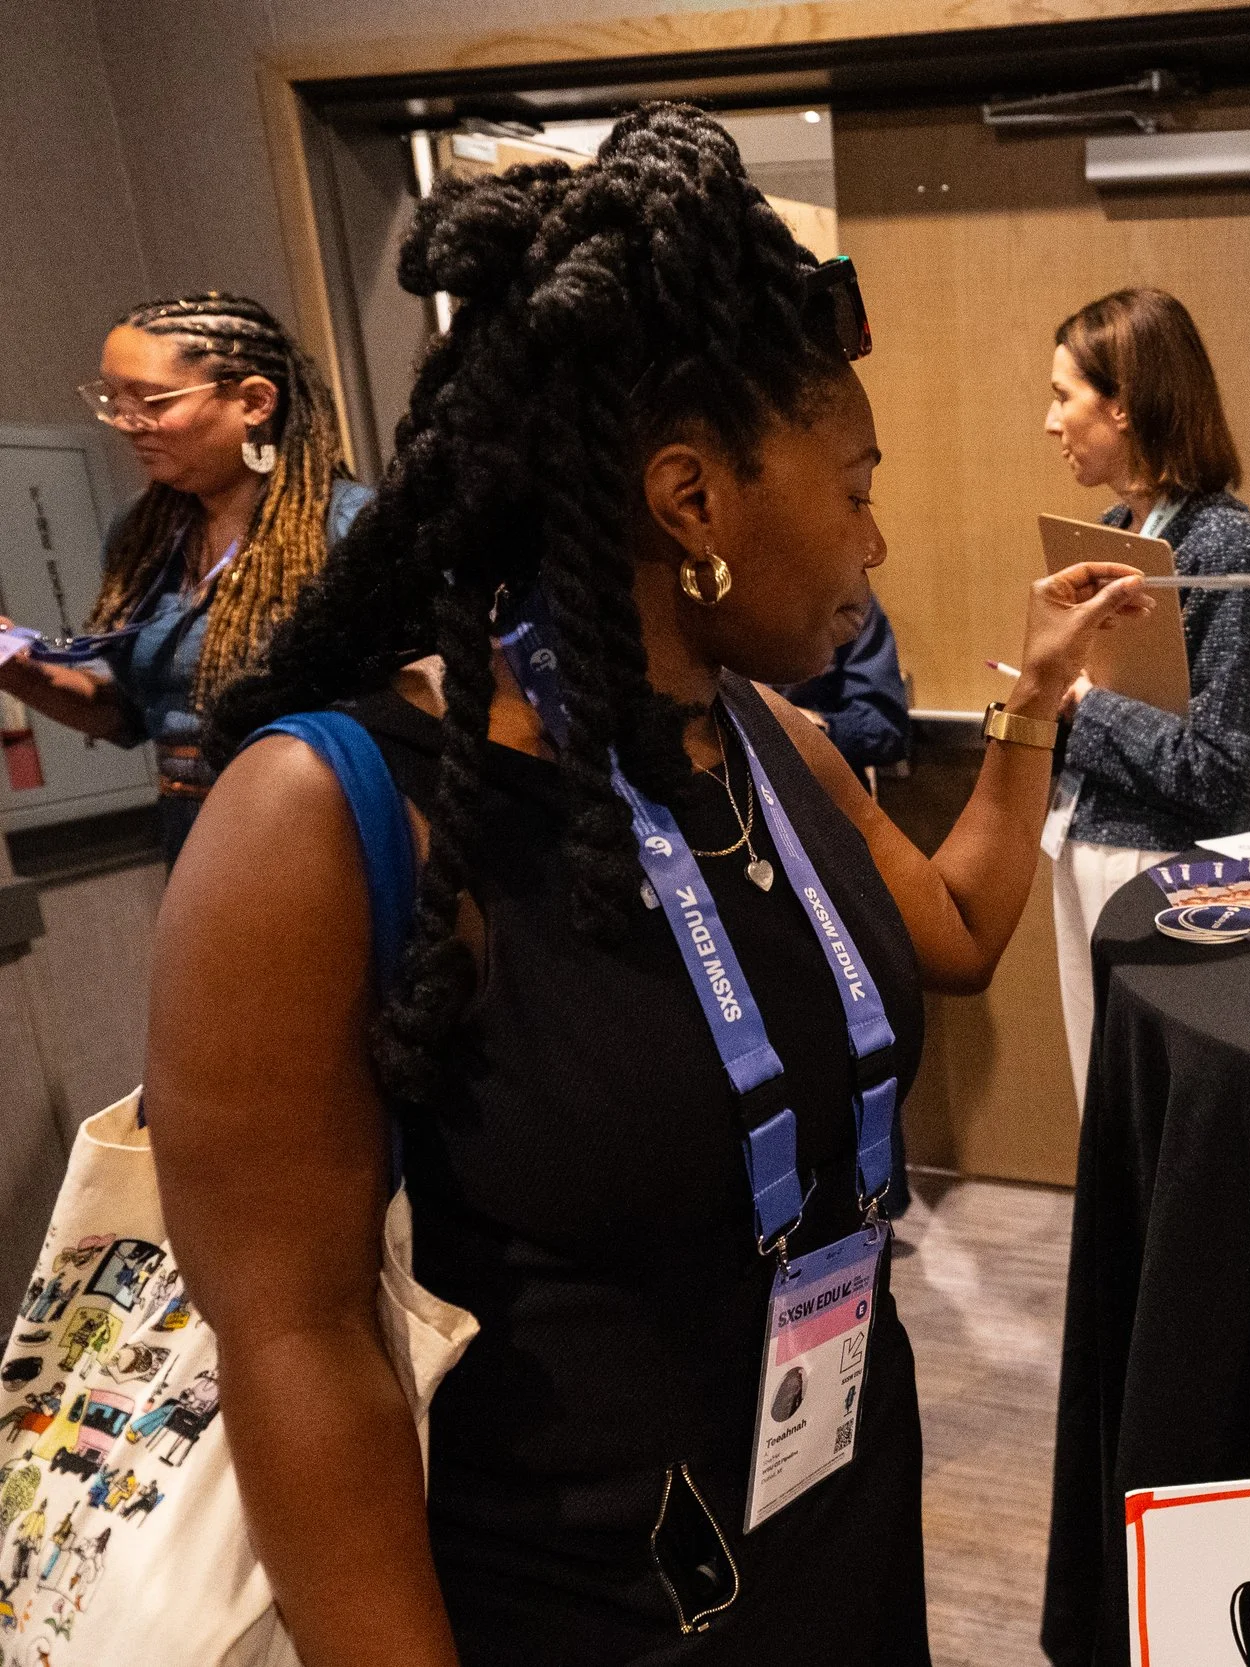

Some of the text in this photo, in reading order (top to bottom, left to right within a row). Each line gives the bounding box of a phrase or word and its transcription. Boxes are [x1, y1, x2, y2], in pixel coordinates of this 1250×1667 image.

[684, 911, 742, 1023] SXSW EDU
[804, 886, 858, 980] SXSW EDU
[777, 1286, 842, 1328] SXSW EDU
[858, 1304, 865, 1315] E
